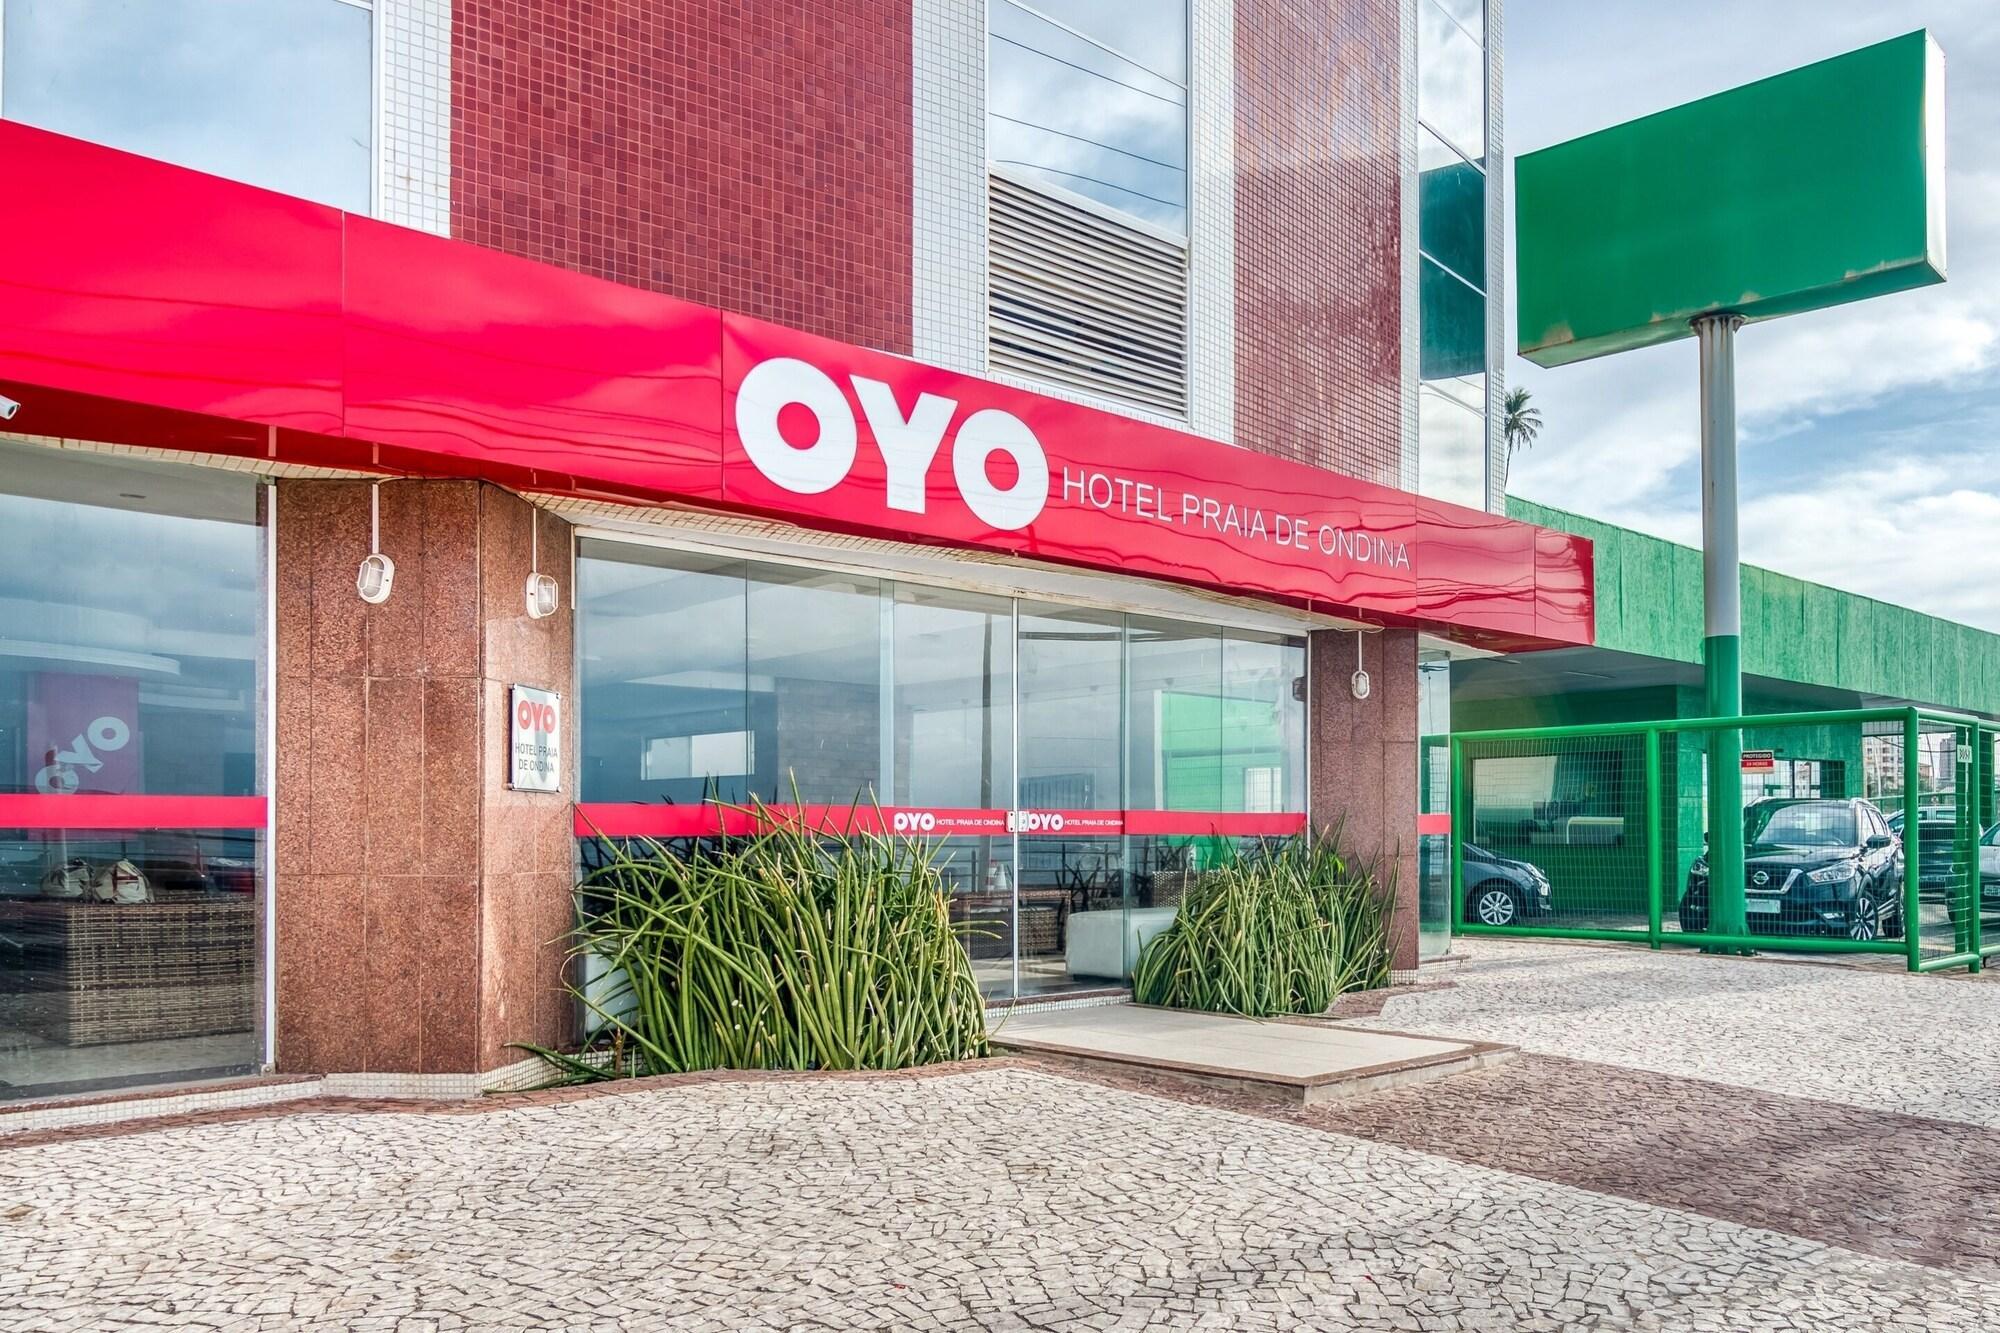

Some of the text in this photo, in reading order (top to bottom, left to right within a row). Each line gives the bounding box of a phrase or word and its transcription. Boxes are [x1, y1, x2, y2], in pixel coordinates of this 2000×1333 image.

[735, 357, 1411, 570] OYO HOTEL PRAIA DE ONDINA
[518, 700, 556, 734] OYO
[515, 742, 558, 758] HOTEL PRAIA
[518, 759, 555, 772] DE ONDINA
[894, 812, 1005, 831] OYO HOTEL PRAIA DE ONDINA
[1028, 813, 1064, 831] OYO
